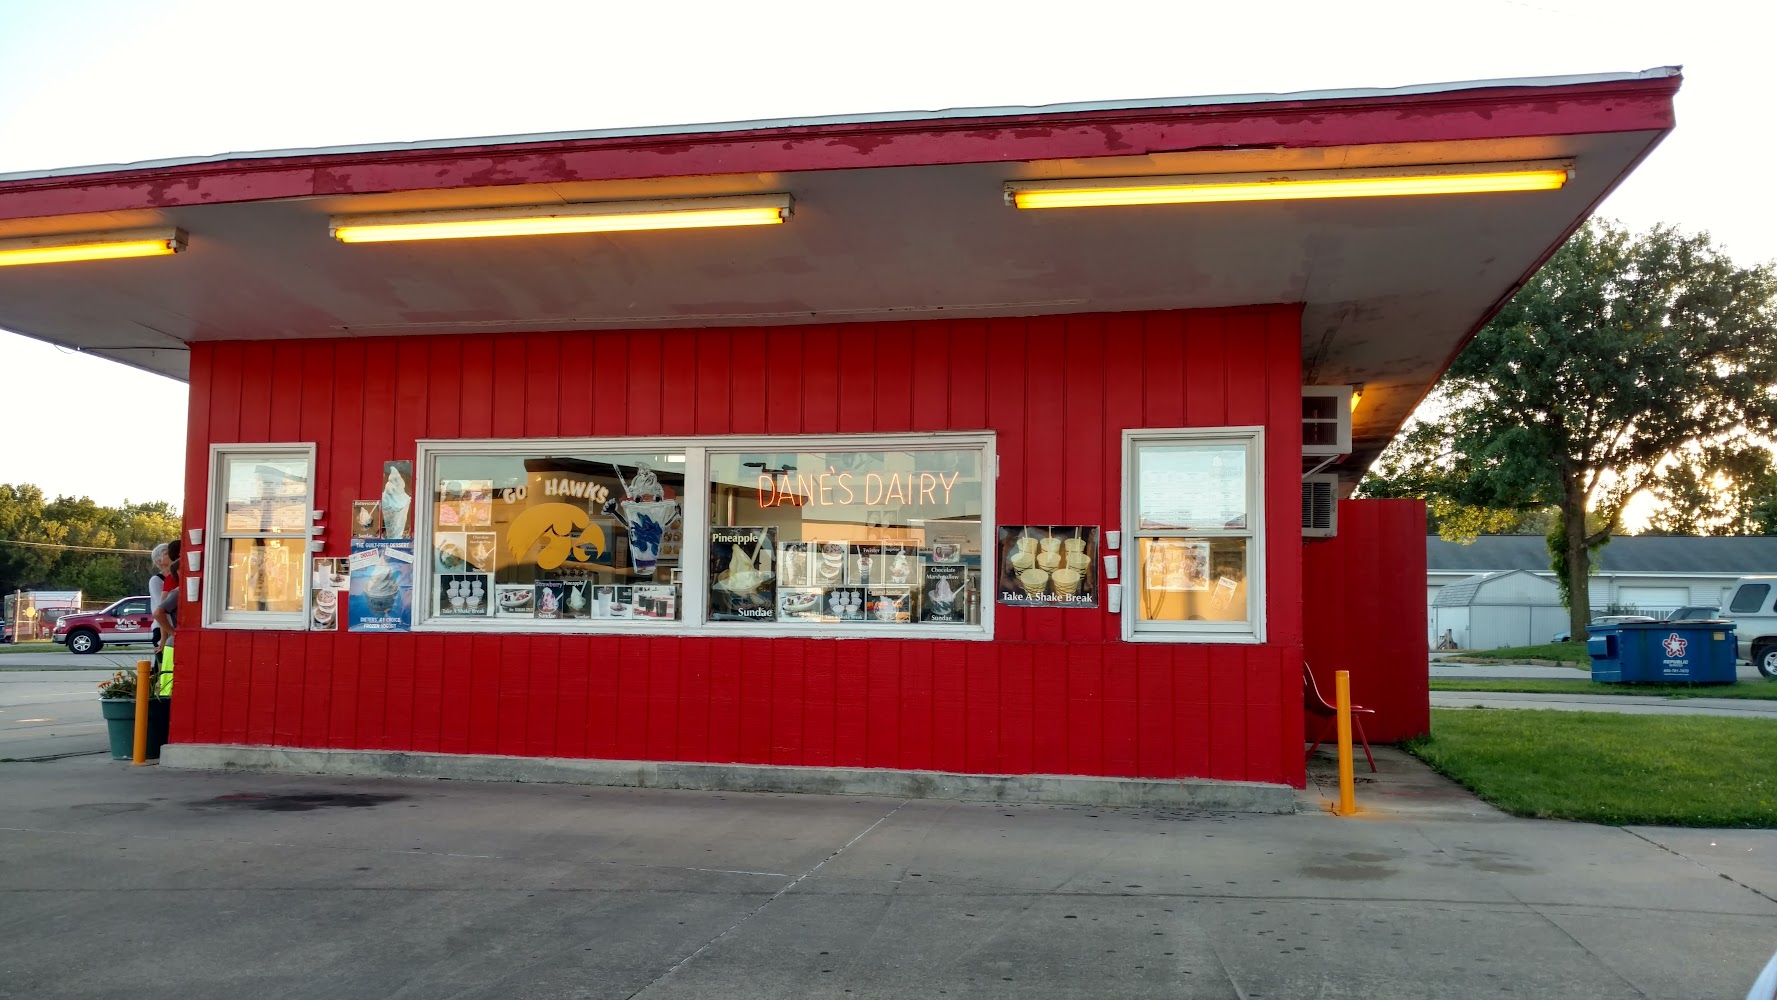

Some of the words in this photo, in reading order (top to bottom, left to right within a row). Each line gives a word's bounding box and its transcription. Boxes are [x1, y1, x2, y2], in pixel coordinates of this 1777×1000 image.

[502, 485, 528, 504] GO
[544, 477, 609, 504] HAWKS
[757, 465, 854, 509] DANE'S
[865, 471, 960, 506] DAIRY
[712, 532, 759, 545] Pineapple
[1002, 591, 1024, 602] Take
[1025, 592, 1033, 602] A
[1035, 591, 1063, 603] Shake
[1065, 592, 1093, 603] Break
[737, 606, 773, 618] Sundae
